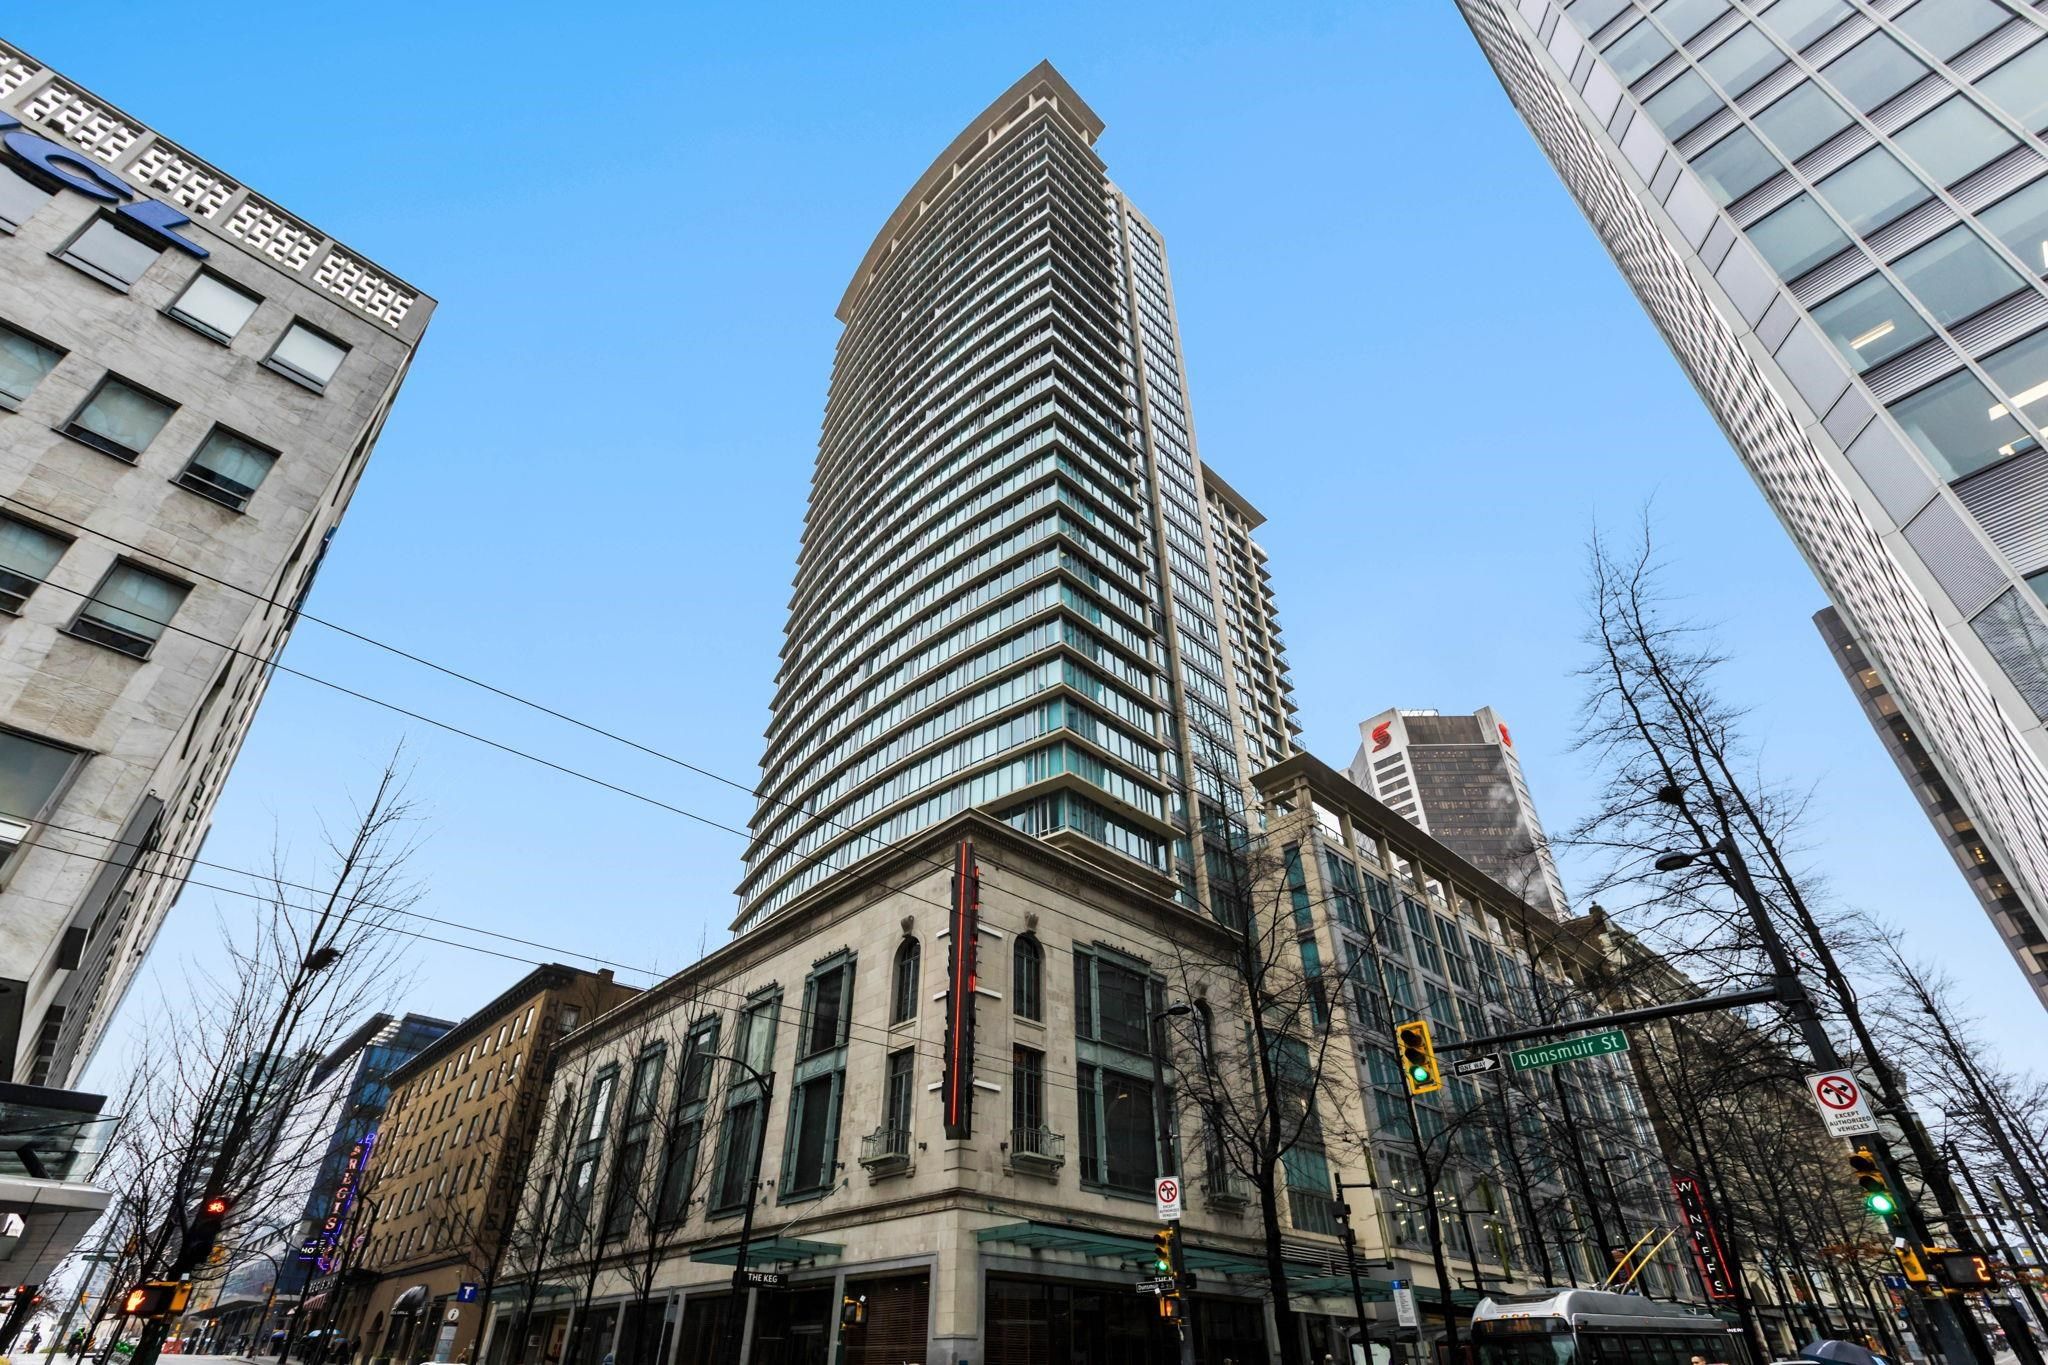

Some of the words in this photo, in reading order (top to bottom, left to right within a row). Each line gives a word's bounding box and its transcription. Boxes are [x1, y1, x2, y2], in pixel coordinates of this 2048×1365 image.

[1518, 1040, 1594, 1068] Dunsmuir
[1601, 1035, 1620, 1051] St
[1473, 1061, 1486, 1069] WAY
[1834, 1110, 1860, 1120] EXCEPT
[1829, 1115, 1872, 1127] AUTHORIZED
[1836, 1122, 1870, 1133] VEHICLES
[1971, 1256, 1991, 1281] 2
[747, 1273, 762, 1282] THE
[763, 1274, 778, 1283] KEG
[463, 1286, 475, 1299] T
